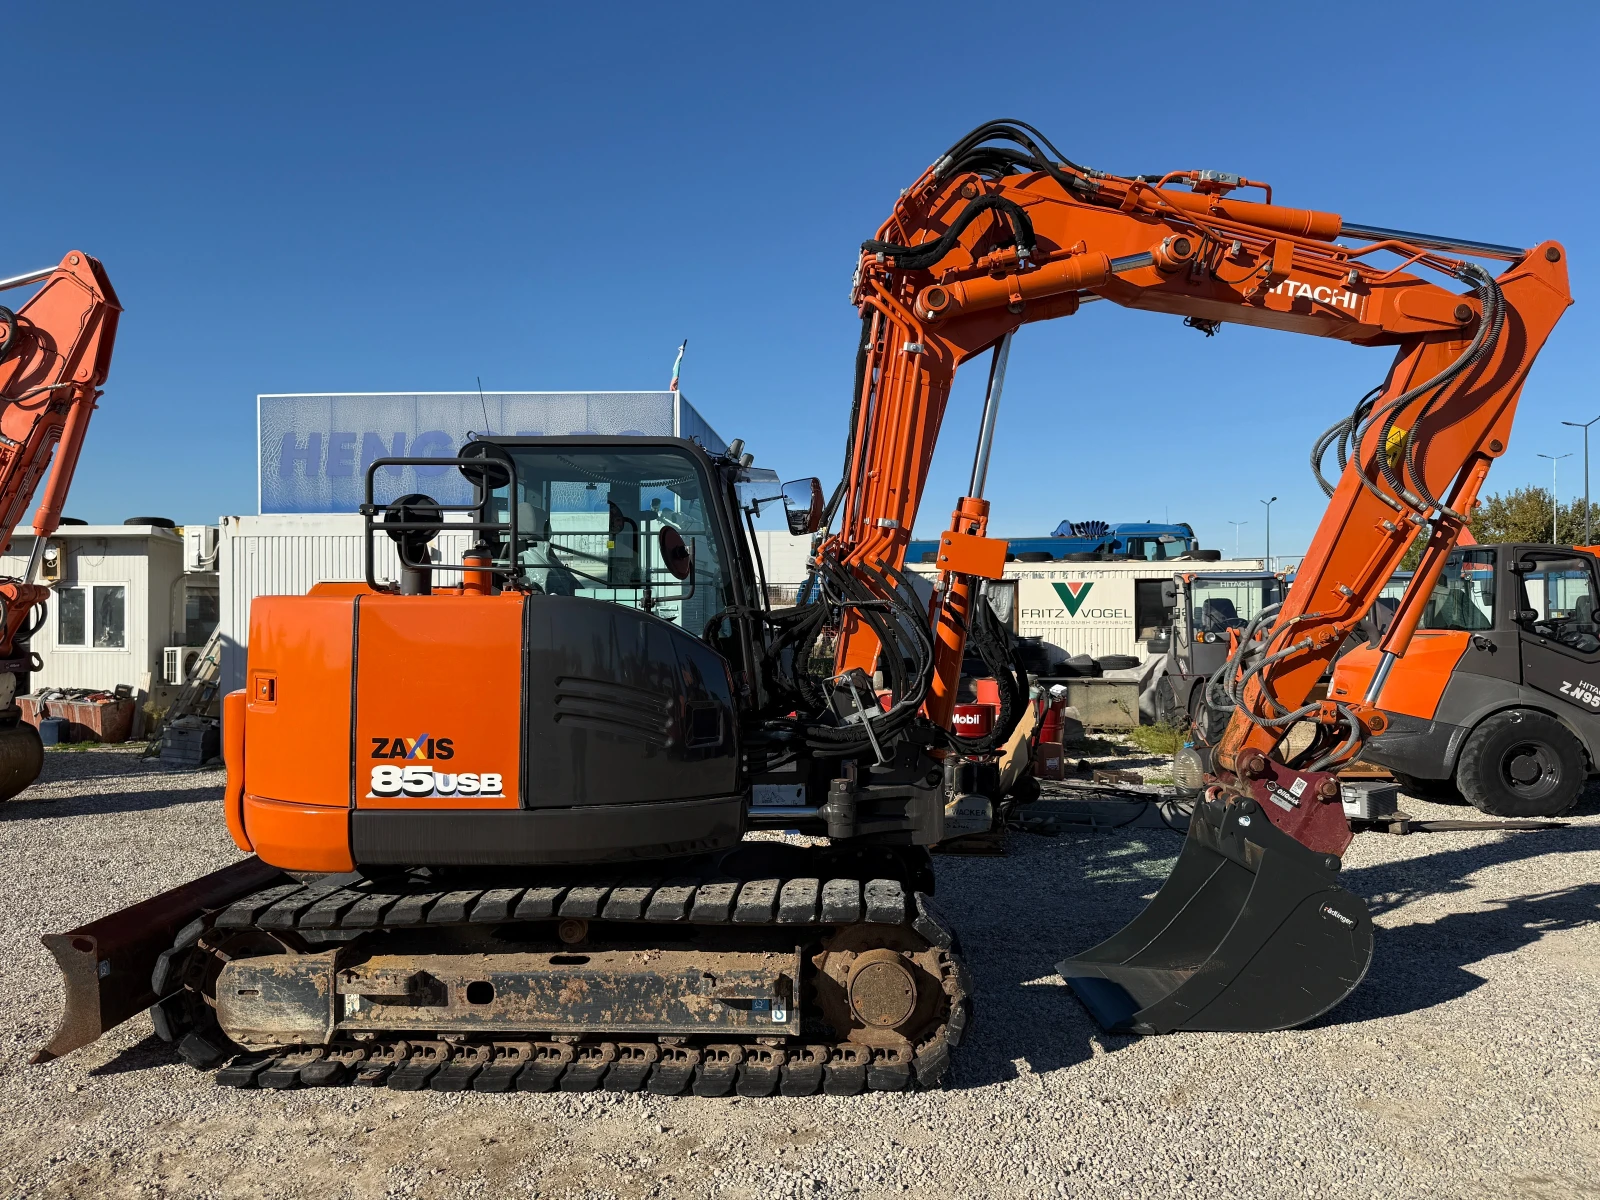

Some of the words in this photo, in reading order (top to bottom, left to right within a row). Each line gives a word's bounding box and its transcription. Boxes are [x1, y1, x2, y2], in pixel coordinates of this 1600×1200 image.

[1268, 279, 1358, 309] ITACHI
[1021, 608, 1065, 618] FRITZ
[1080, 608, 1133, 618] VOGEL
[1579, 680, 1600, 695] HITA
[952, 713, 980, 725] Mobil
[371, 733, 455, 760] ZAXIS
[952, 808, 987, 817] WACKER
